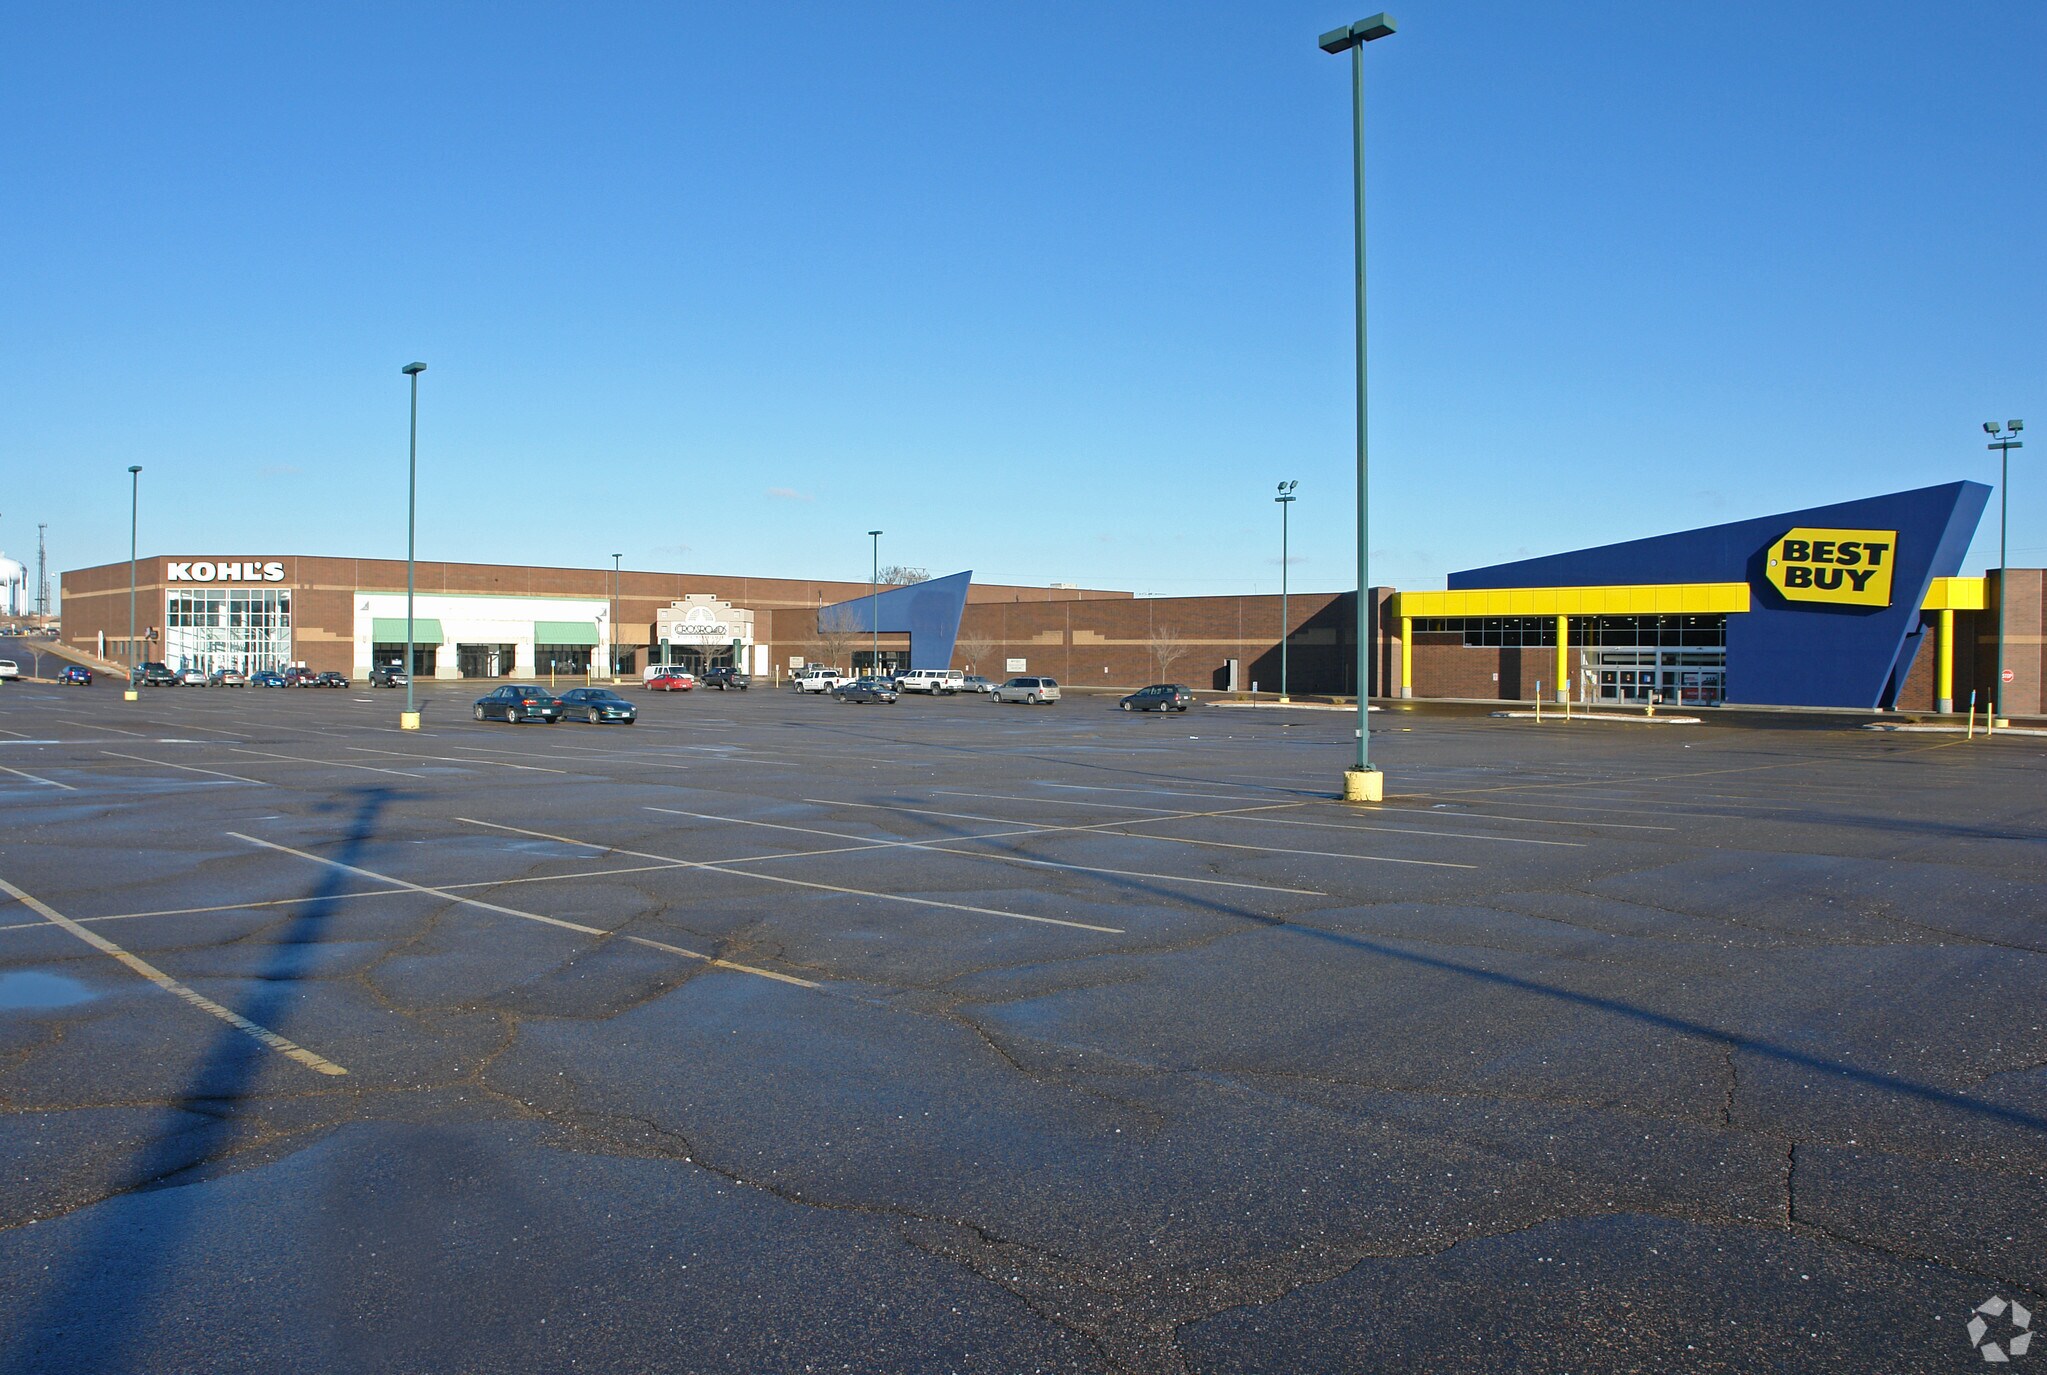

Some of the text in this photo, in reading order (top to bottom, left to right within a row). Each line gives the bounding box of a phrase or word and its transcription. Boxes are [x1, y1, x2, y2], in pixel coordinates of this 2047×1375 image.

[1782, 539, 1889, 566] BEST
[167, 561, 286, 582] KOHL'S
[1784, 565, 1877, 592] BUY
